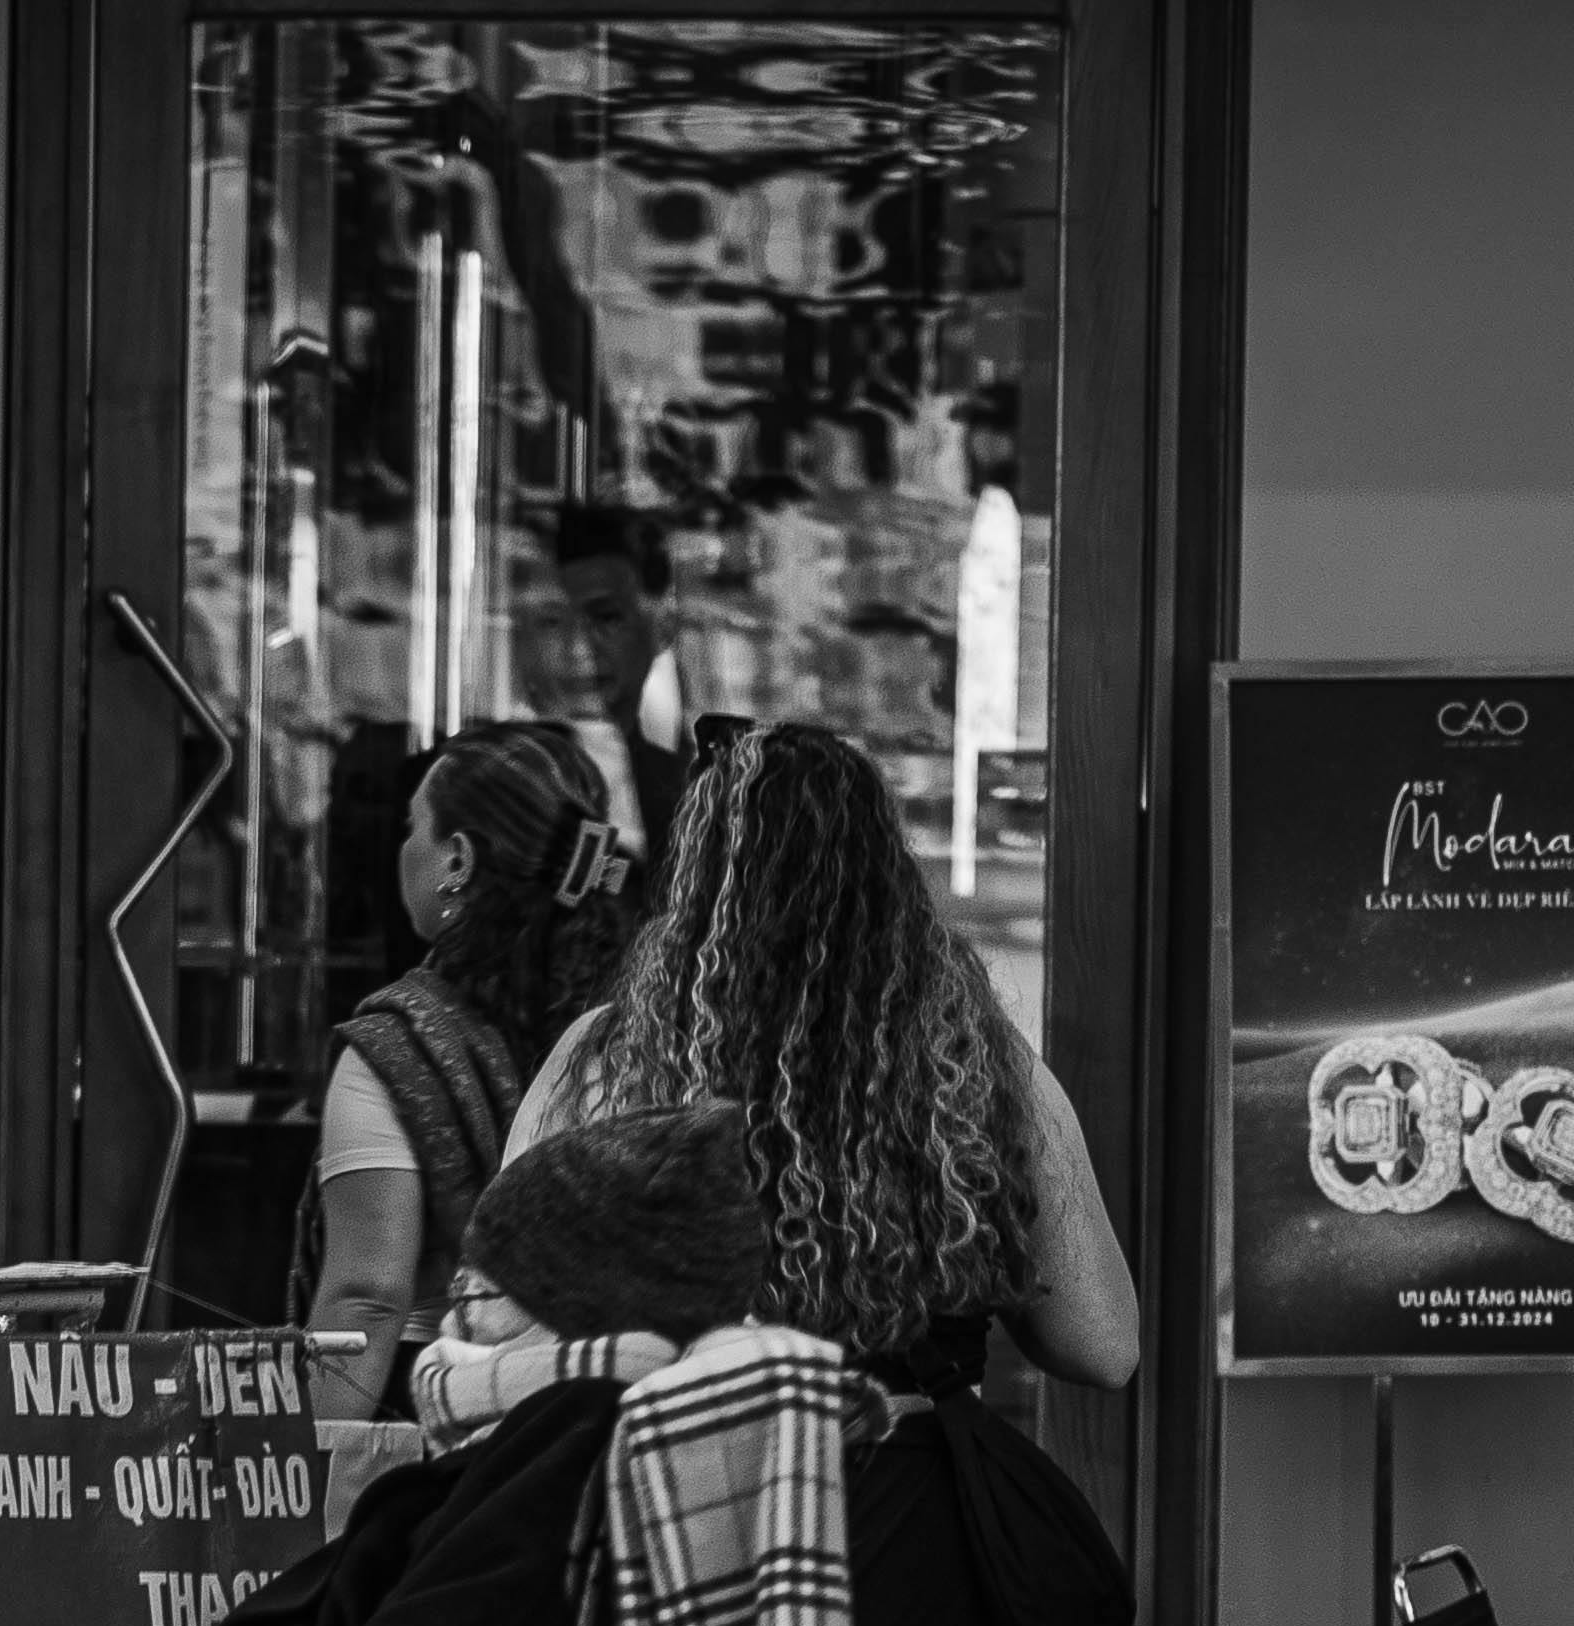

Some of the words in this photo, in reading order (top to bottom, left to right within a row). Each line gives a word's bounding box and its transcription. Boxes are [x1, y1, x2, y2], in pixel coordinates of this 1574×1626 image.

[1412, 780, 1445, 796] BST
[1541, 858, 1574, 870] MATC
[1542, 888, 1574, 910] RIÊ
[1421, 1312, 1440, 1327] 10
[1459, 1311, 1554, 1327] 31.12.2024
[154, 1377, 178, 1395] -
[85, 1486, 100, 1500] -
[234, 1441, 311, 1519] ĐÀO
